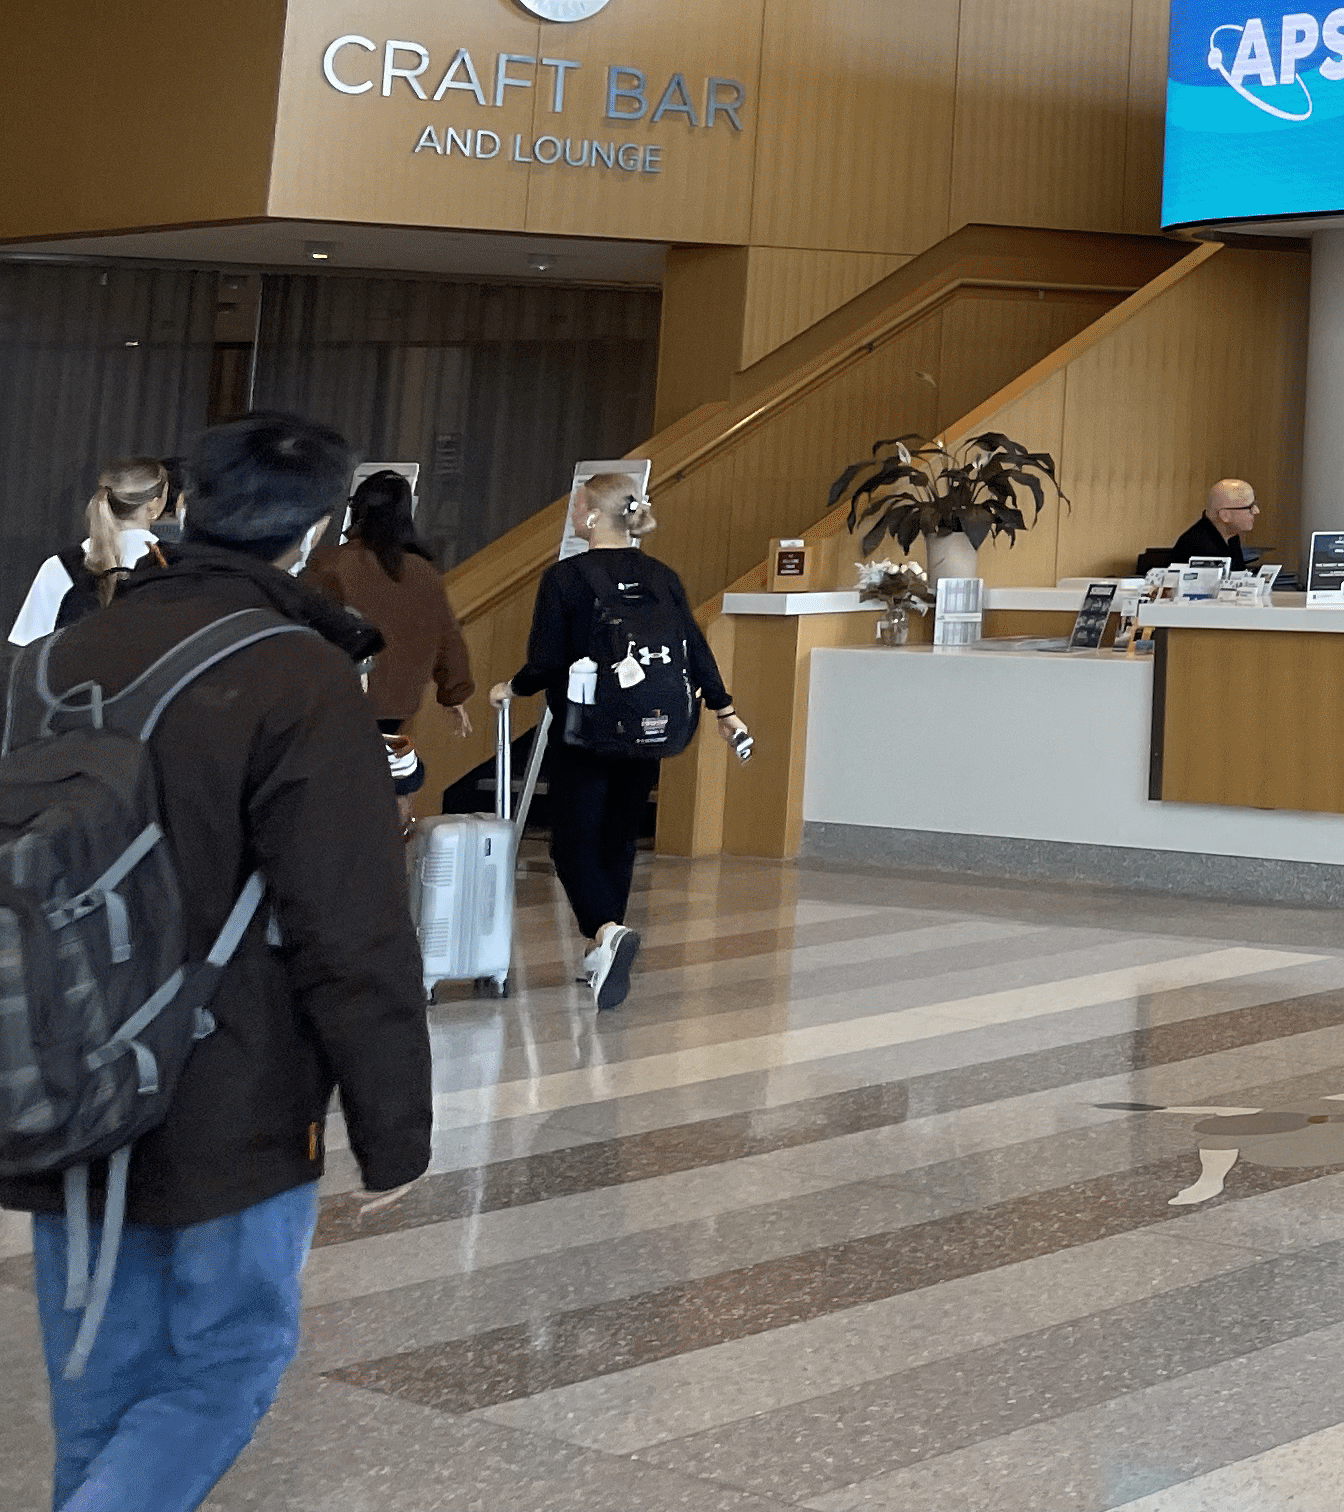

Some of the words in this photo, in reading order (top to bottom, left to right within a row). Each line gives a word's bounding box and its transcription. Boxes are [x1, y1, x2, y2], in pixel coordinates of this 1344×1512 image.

[323, 34, 582, 113] CRAFT
[605, 64, 747, 131] BAR
[413, 125, 501, 160] AND
[513, 133, 664, 173] LOUNGE
